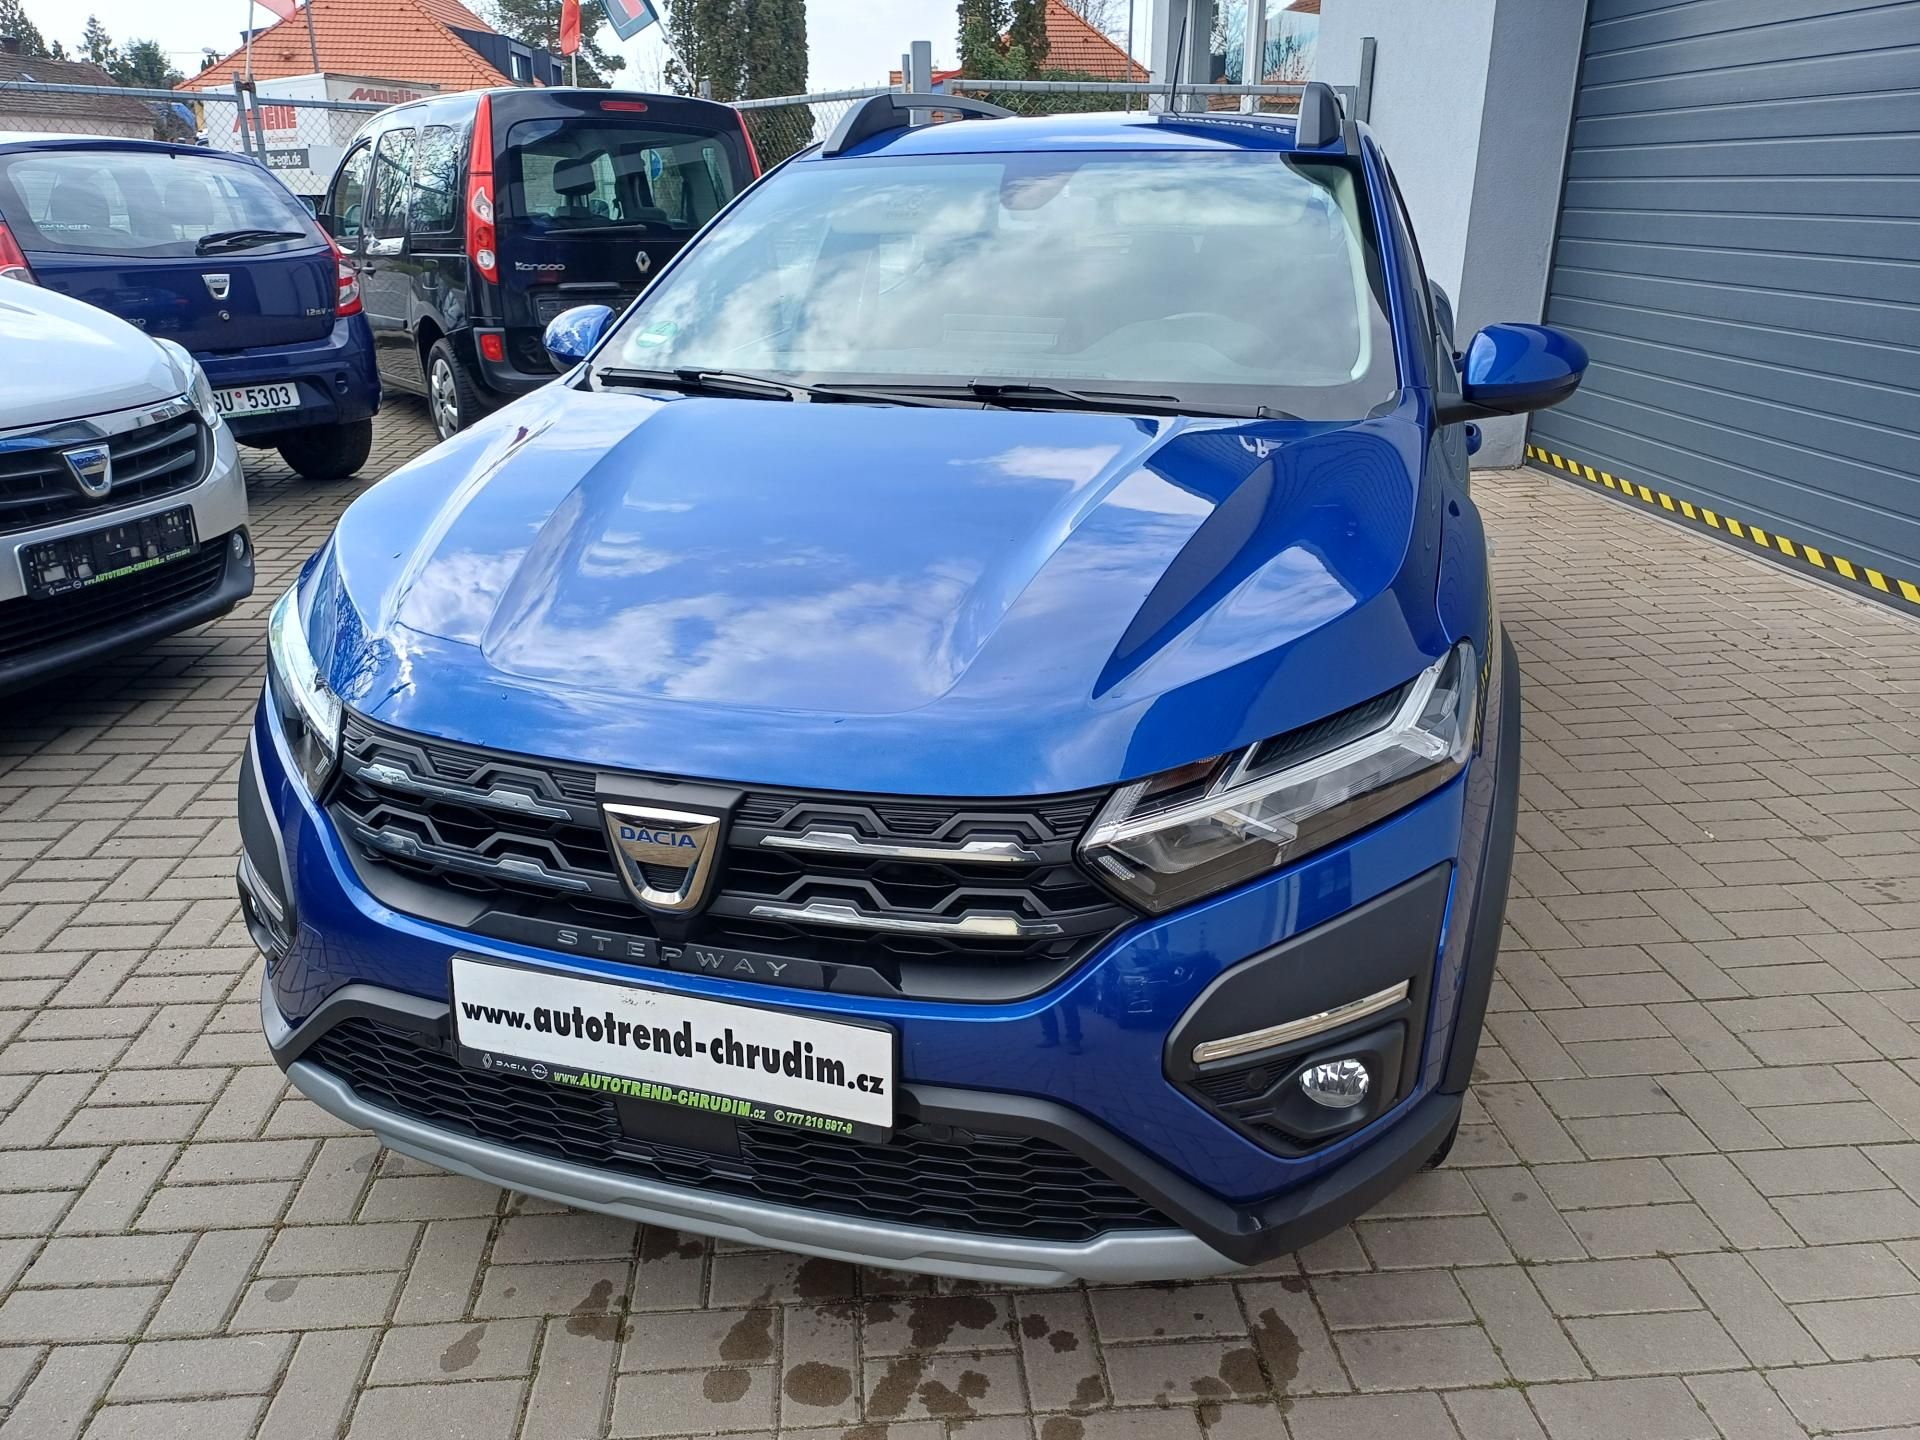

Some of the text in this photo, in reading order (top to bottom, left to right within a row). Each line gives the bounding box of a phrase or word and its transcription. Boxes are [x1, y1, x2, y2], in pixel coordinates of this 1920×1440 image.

[246, 386, 291, 409] 5303
[620, 826, 697, 849] DACIA
[557, 929, 788, 977] STEPWAY
[462, 1001, 885, 1095] www.autotrend-chrudim.cz
[496, 1060, 528, 1072] DACIA
[786, 1112, 805, 1125] 777
